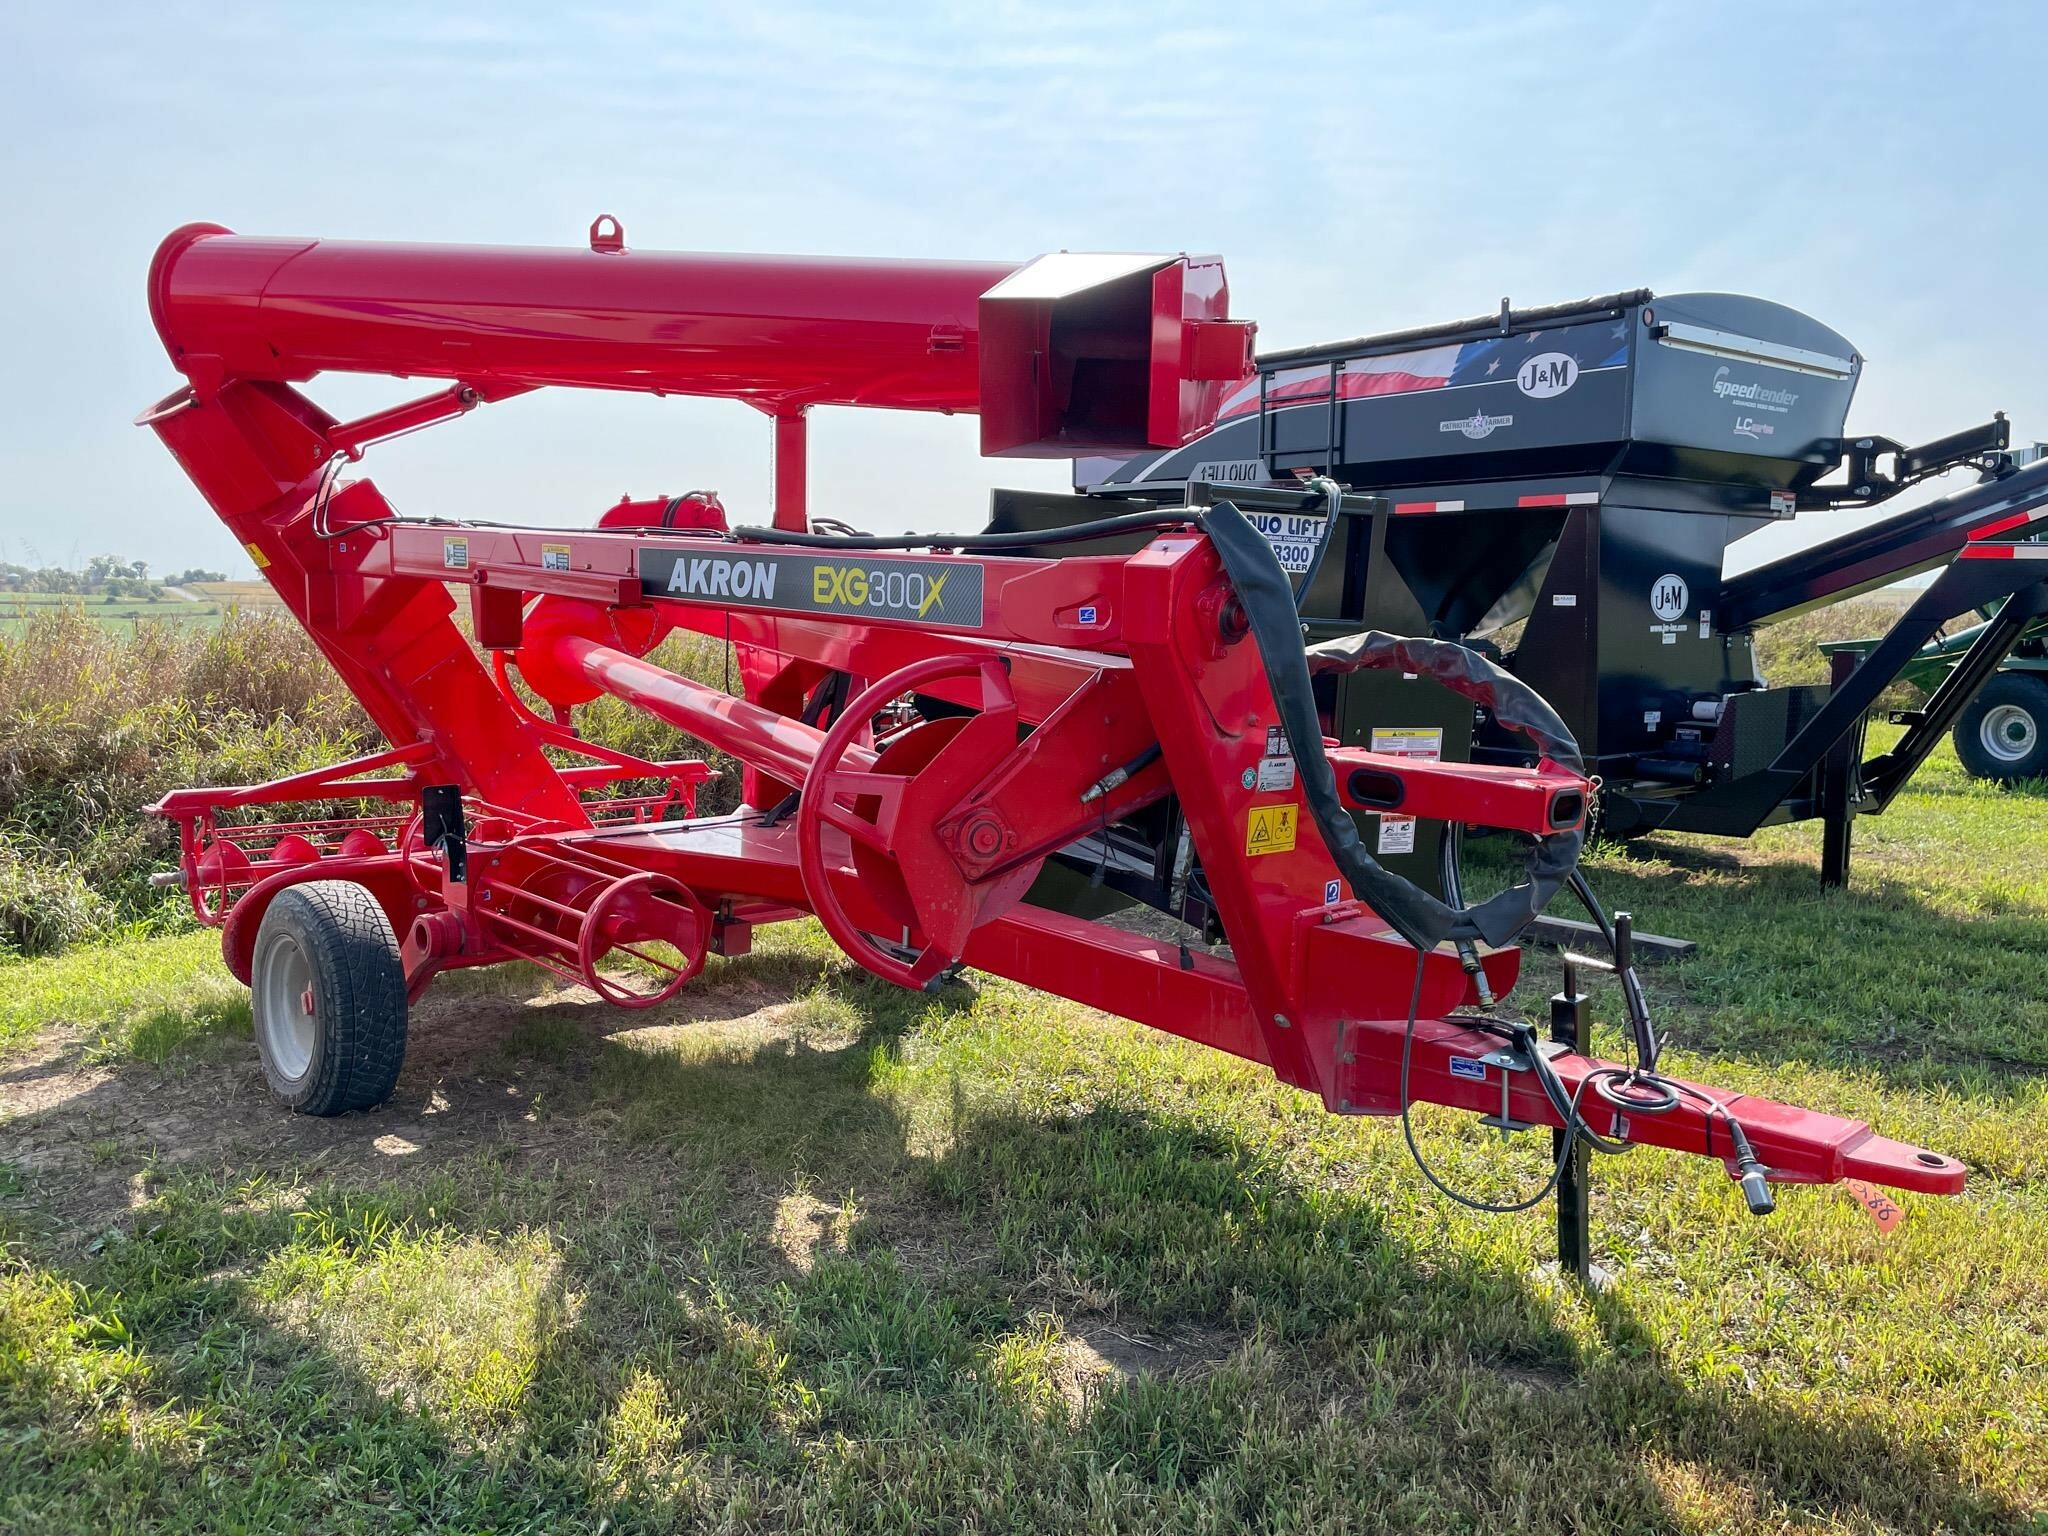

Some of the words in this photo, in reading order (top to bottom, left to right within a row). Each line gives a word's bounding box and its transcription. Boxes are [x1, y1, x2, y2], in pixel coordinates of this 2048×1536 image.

[1522, 360, 1570, 391] J&M
[1441, 420, 1472, 430] PATRIOTIC
[1486, 416, 1511, 426] FARMER
[1273, 544, 1310, 563] R300
[667, 557, 777, 600] AKRON
[1279, 562, 1308, 571] OLLER
[812, 566, 950, 618] EXG300X
[1655, 585, 1682, 610] J&M
